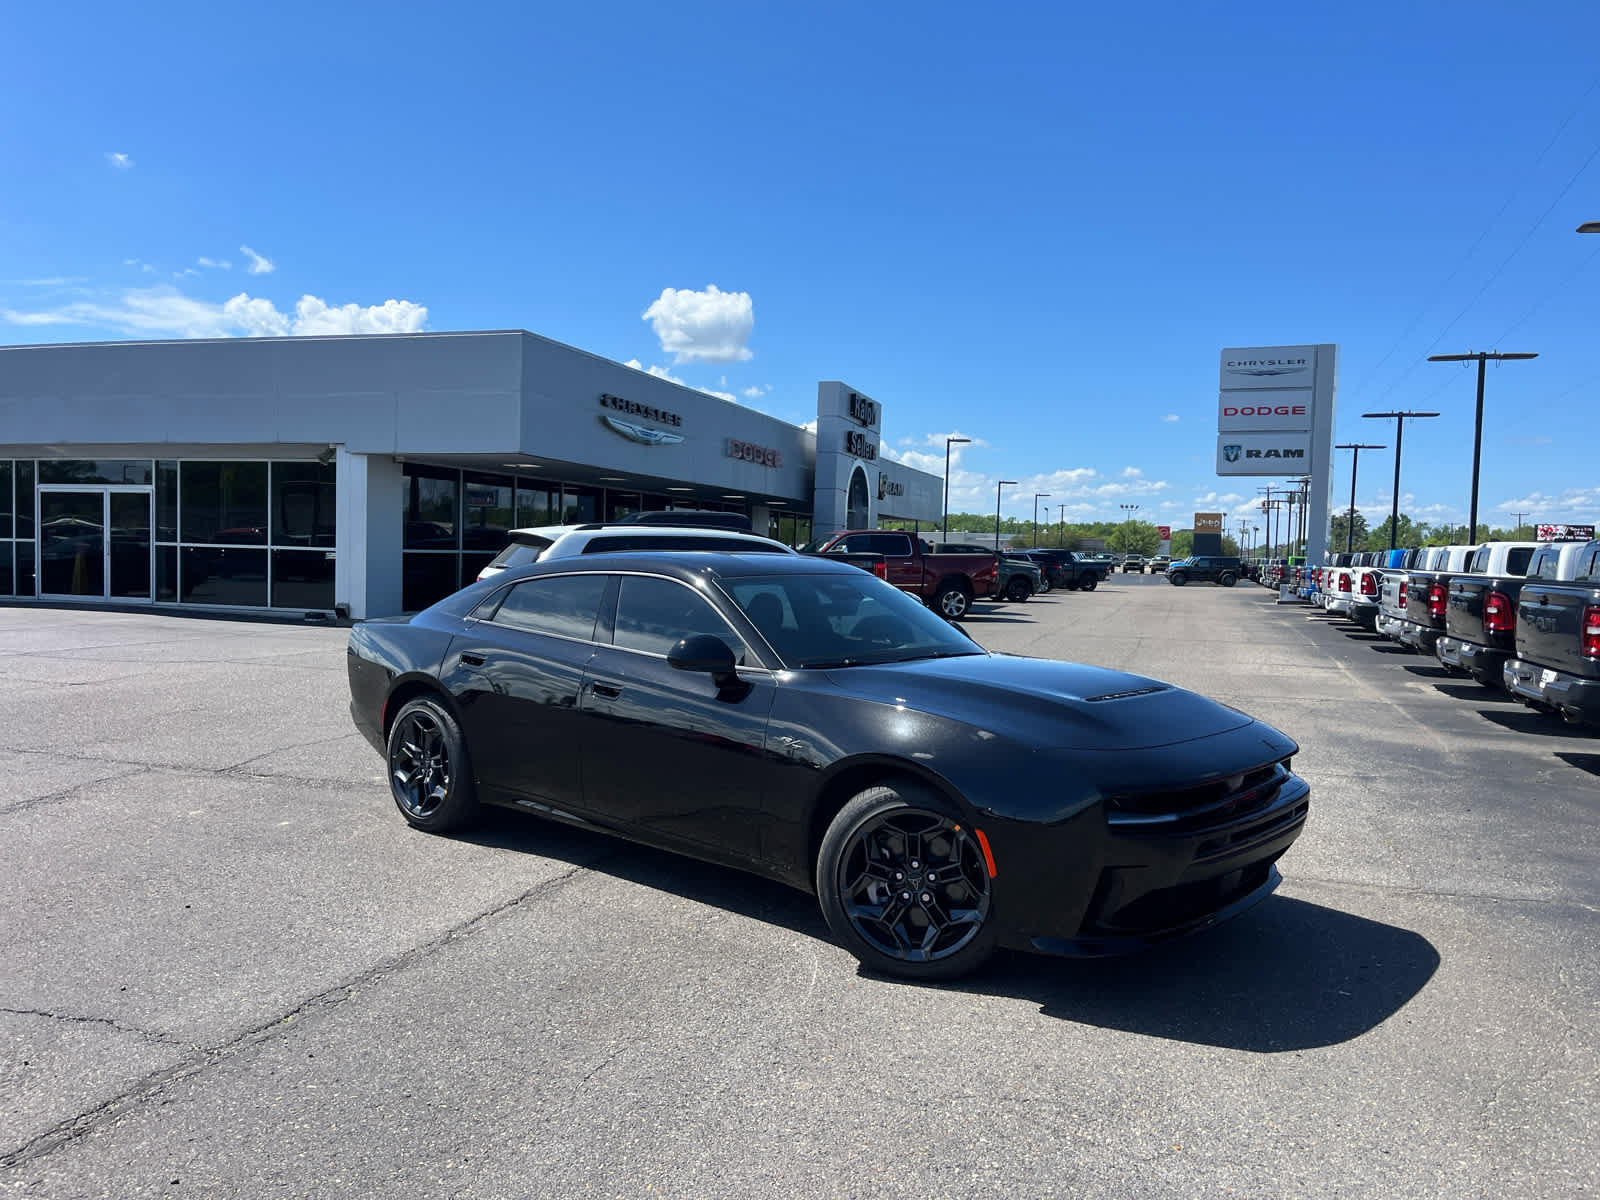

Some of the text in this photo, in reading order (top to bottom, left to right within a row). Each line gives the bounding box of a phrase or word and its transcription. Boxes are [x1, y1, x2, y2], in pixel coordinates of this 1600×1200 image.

[1227, 359, 1306, 367] CHRYSLER
[1223, 406, 1306, 416] DODGE
[728, 439, 783, 468] DODGE
[1246, 449, 1304, 459] RAM
